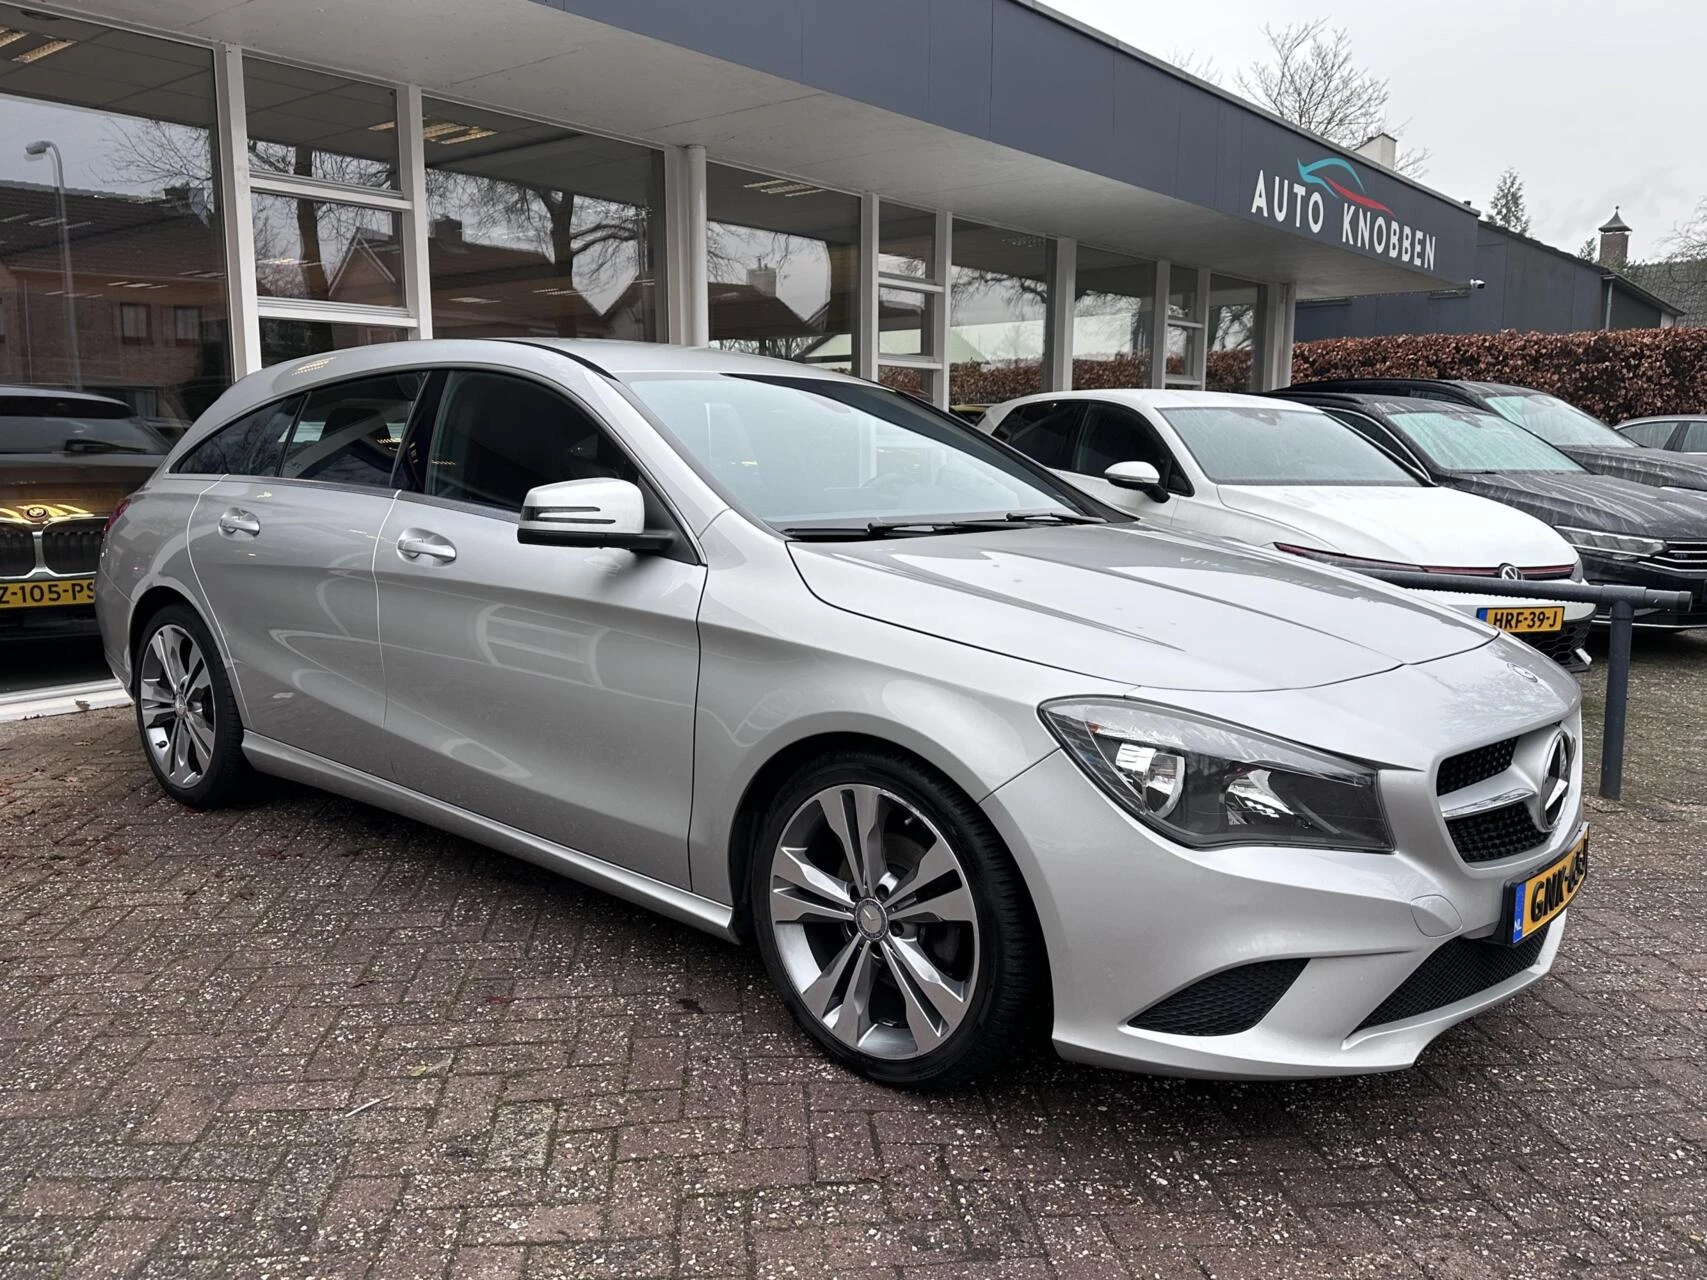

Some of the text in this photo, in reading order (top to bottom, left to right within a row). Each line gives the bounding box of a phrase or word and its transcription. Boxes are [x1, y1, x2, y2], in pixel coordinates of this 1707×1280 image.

[1251, 169, 1436, 271] AUTO KNOBBEN
[1493, 610, 1558, 629] HRF-39-J
[1514, 918, 1523, 932] NL
